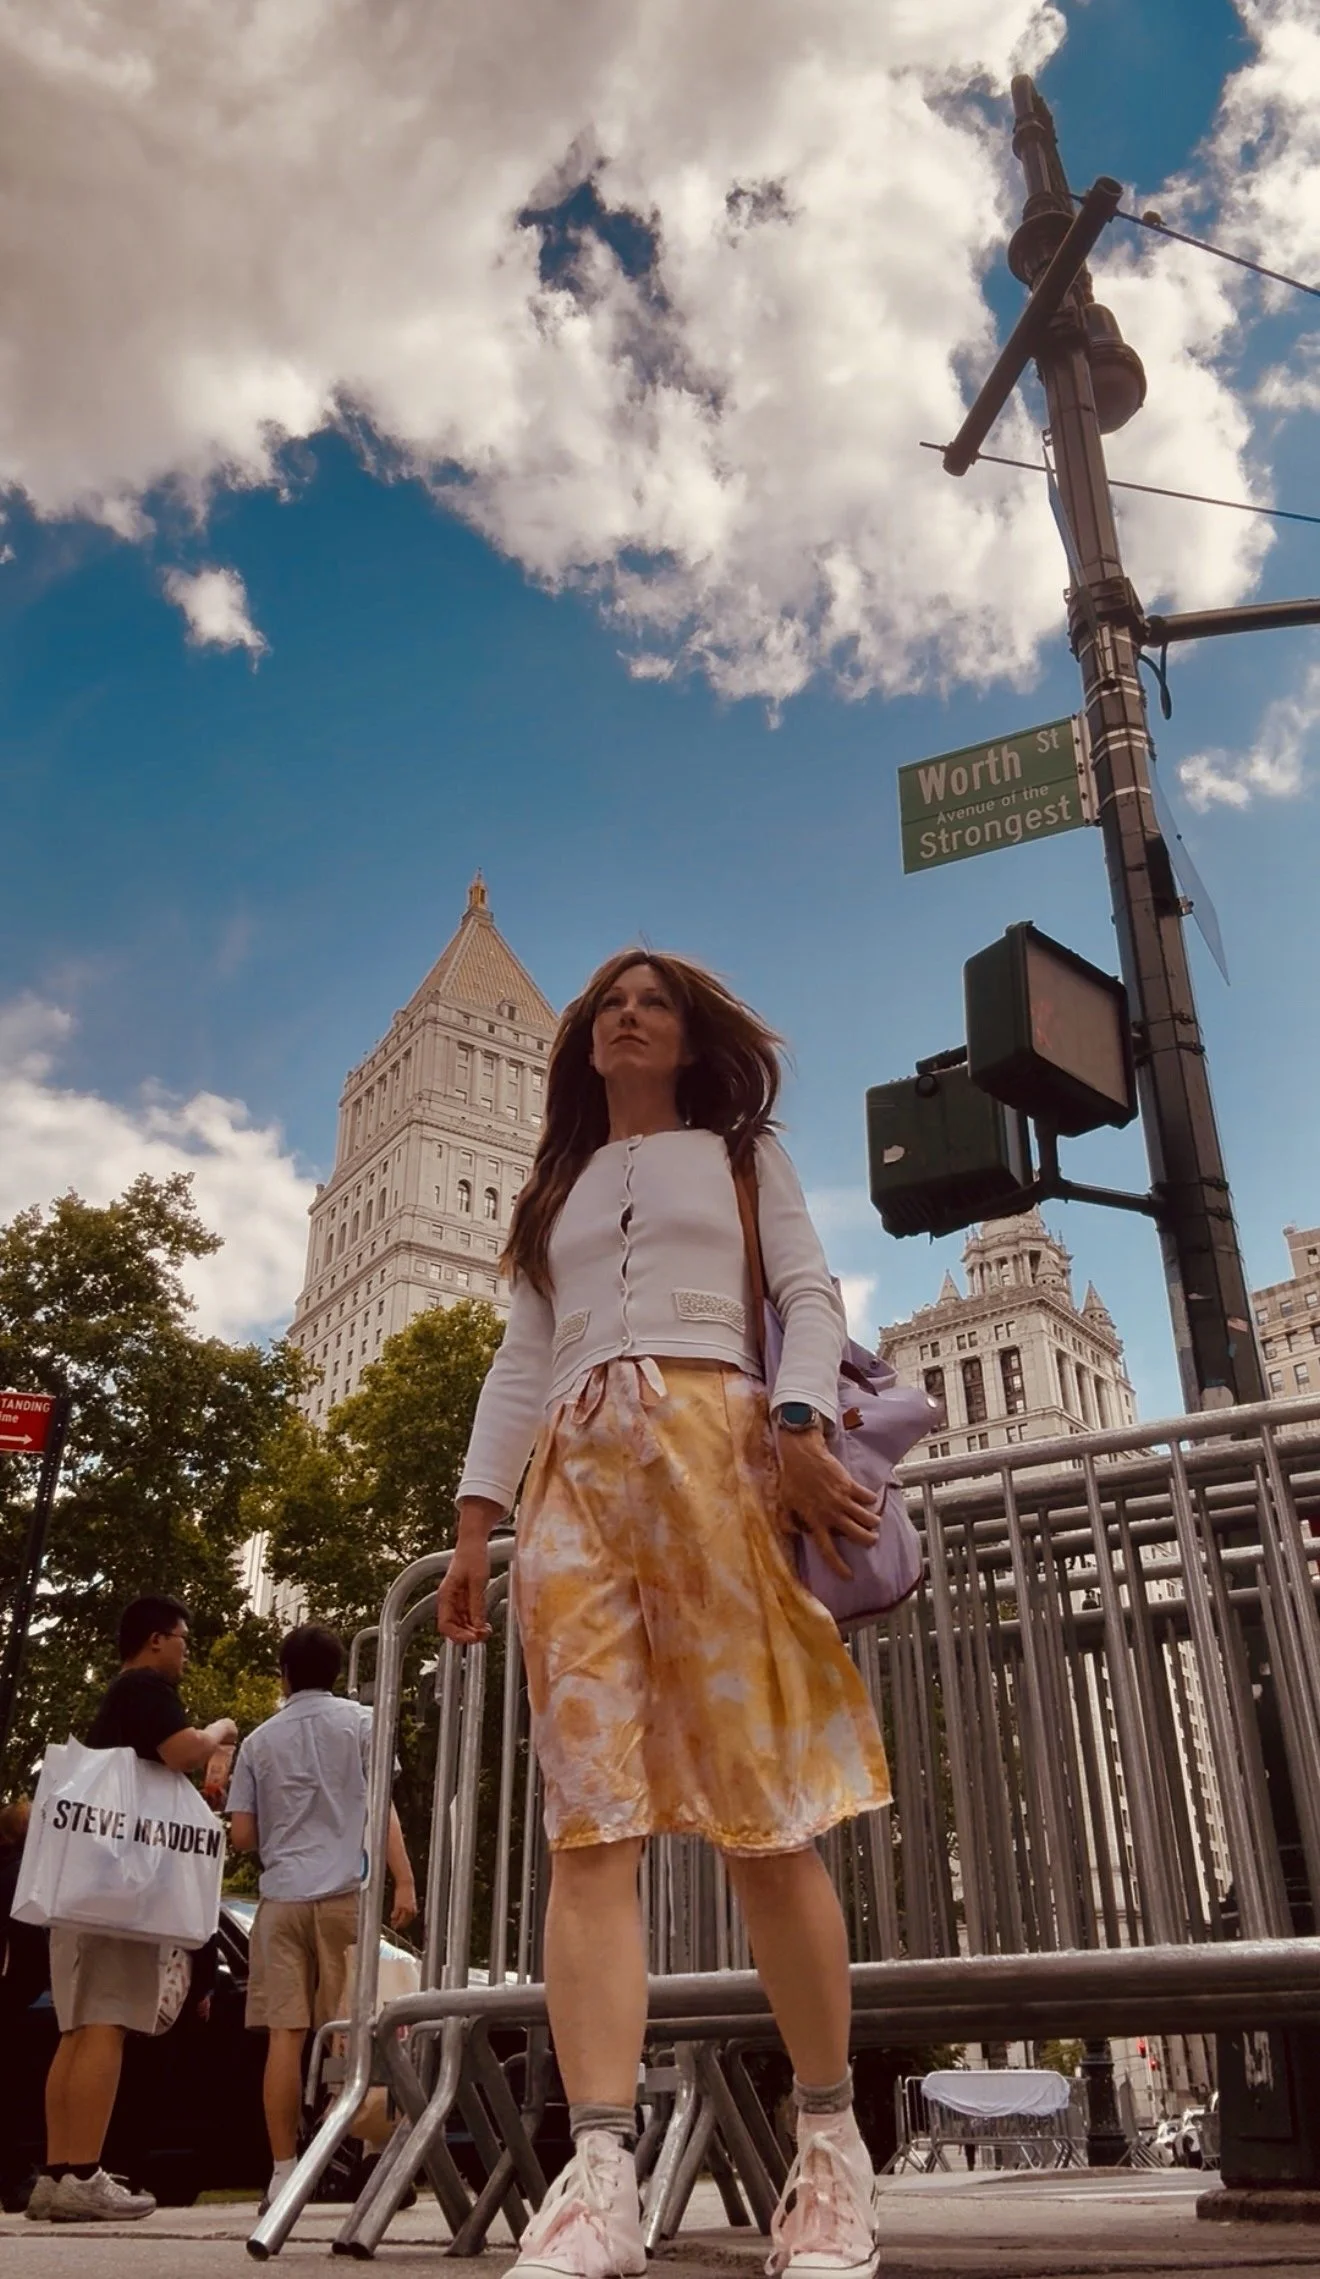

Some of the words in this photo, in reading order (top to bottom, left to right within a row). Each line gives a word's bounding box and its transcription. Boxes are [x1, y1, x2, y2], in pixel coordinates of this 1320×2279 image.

[918, 745, 1021, 804] Worth
[1036, 728, 1060, 753] St
[919, 795, 1072, 859] Strongest
[936, 799, 995, 825] Avenue
[1001, 791, 1016, 807] of
[1022, 784, 1049, 801] the
[1, 1398, 51, 1413] TANDING
[53, 1799, 127, 1840] STEVE
[133, 1815, 221, 1859] MADDEN
